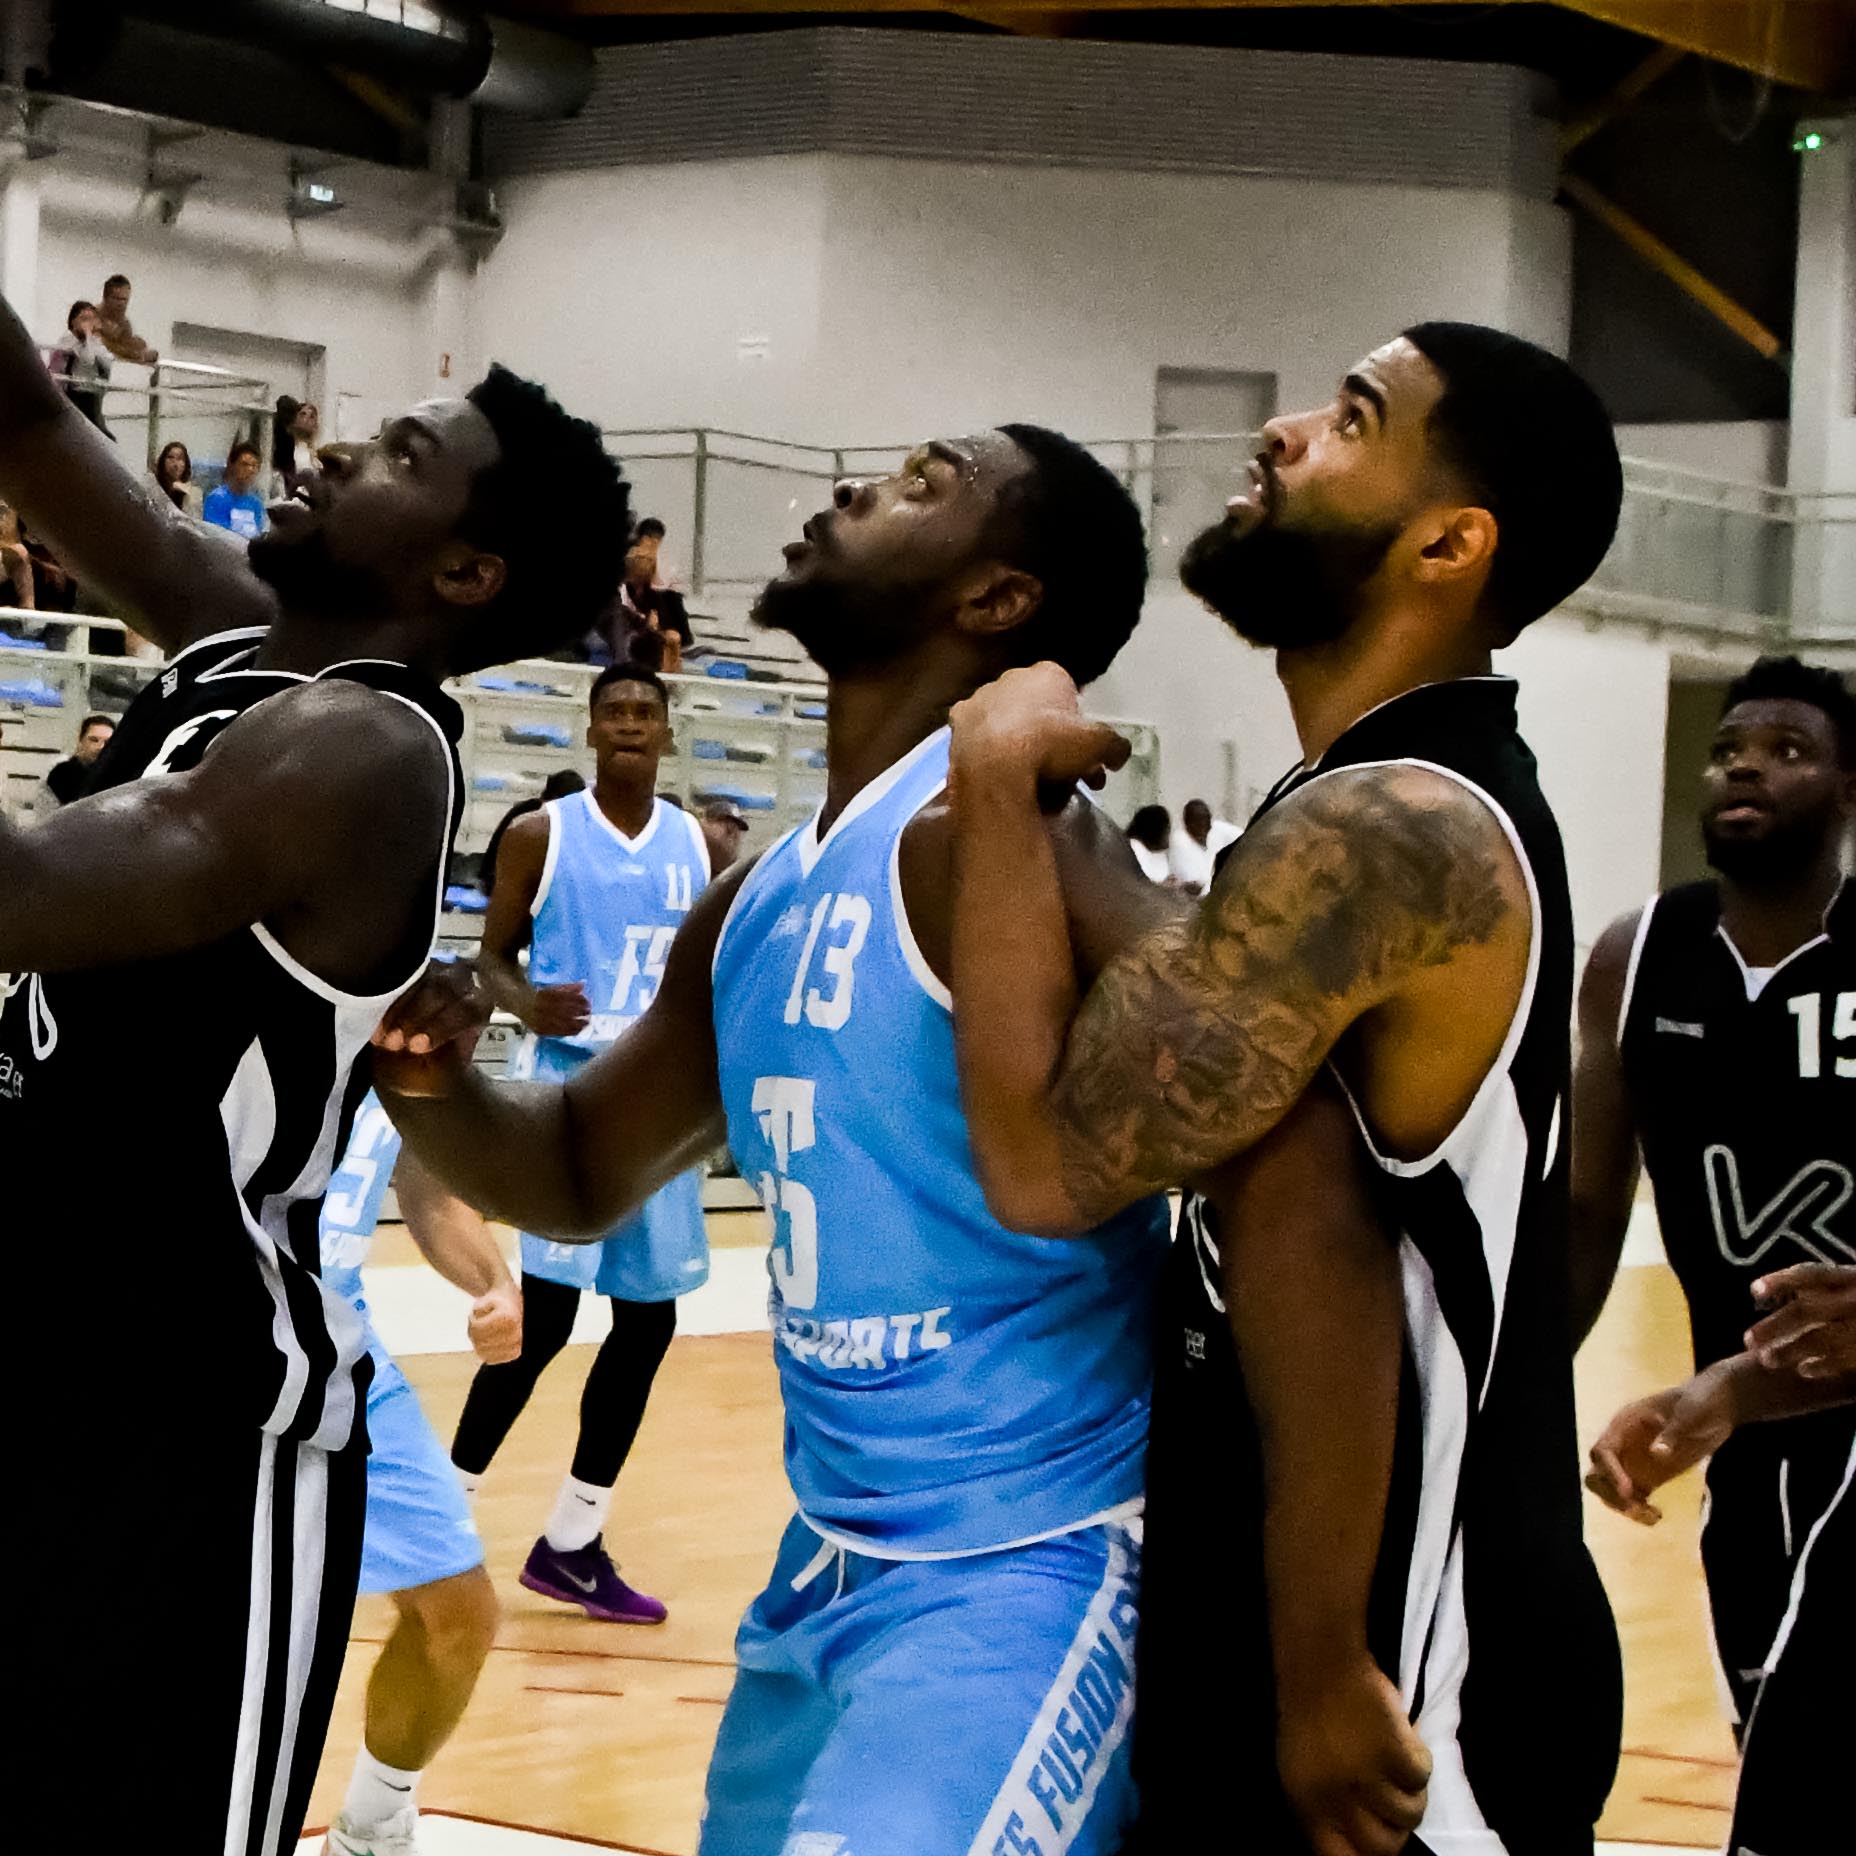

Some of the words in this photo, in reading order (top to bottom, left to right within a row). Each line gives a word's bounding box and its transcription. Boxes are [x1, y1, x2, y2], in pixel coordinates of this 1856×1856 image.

[663, 862, 693, 912] 11
[783, 892, 872, 1031] 13
[1026, 1630, 1131, 1835] FUSION
